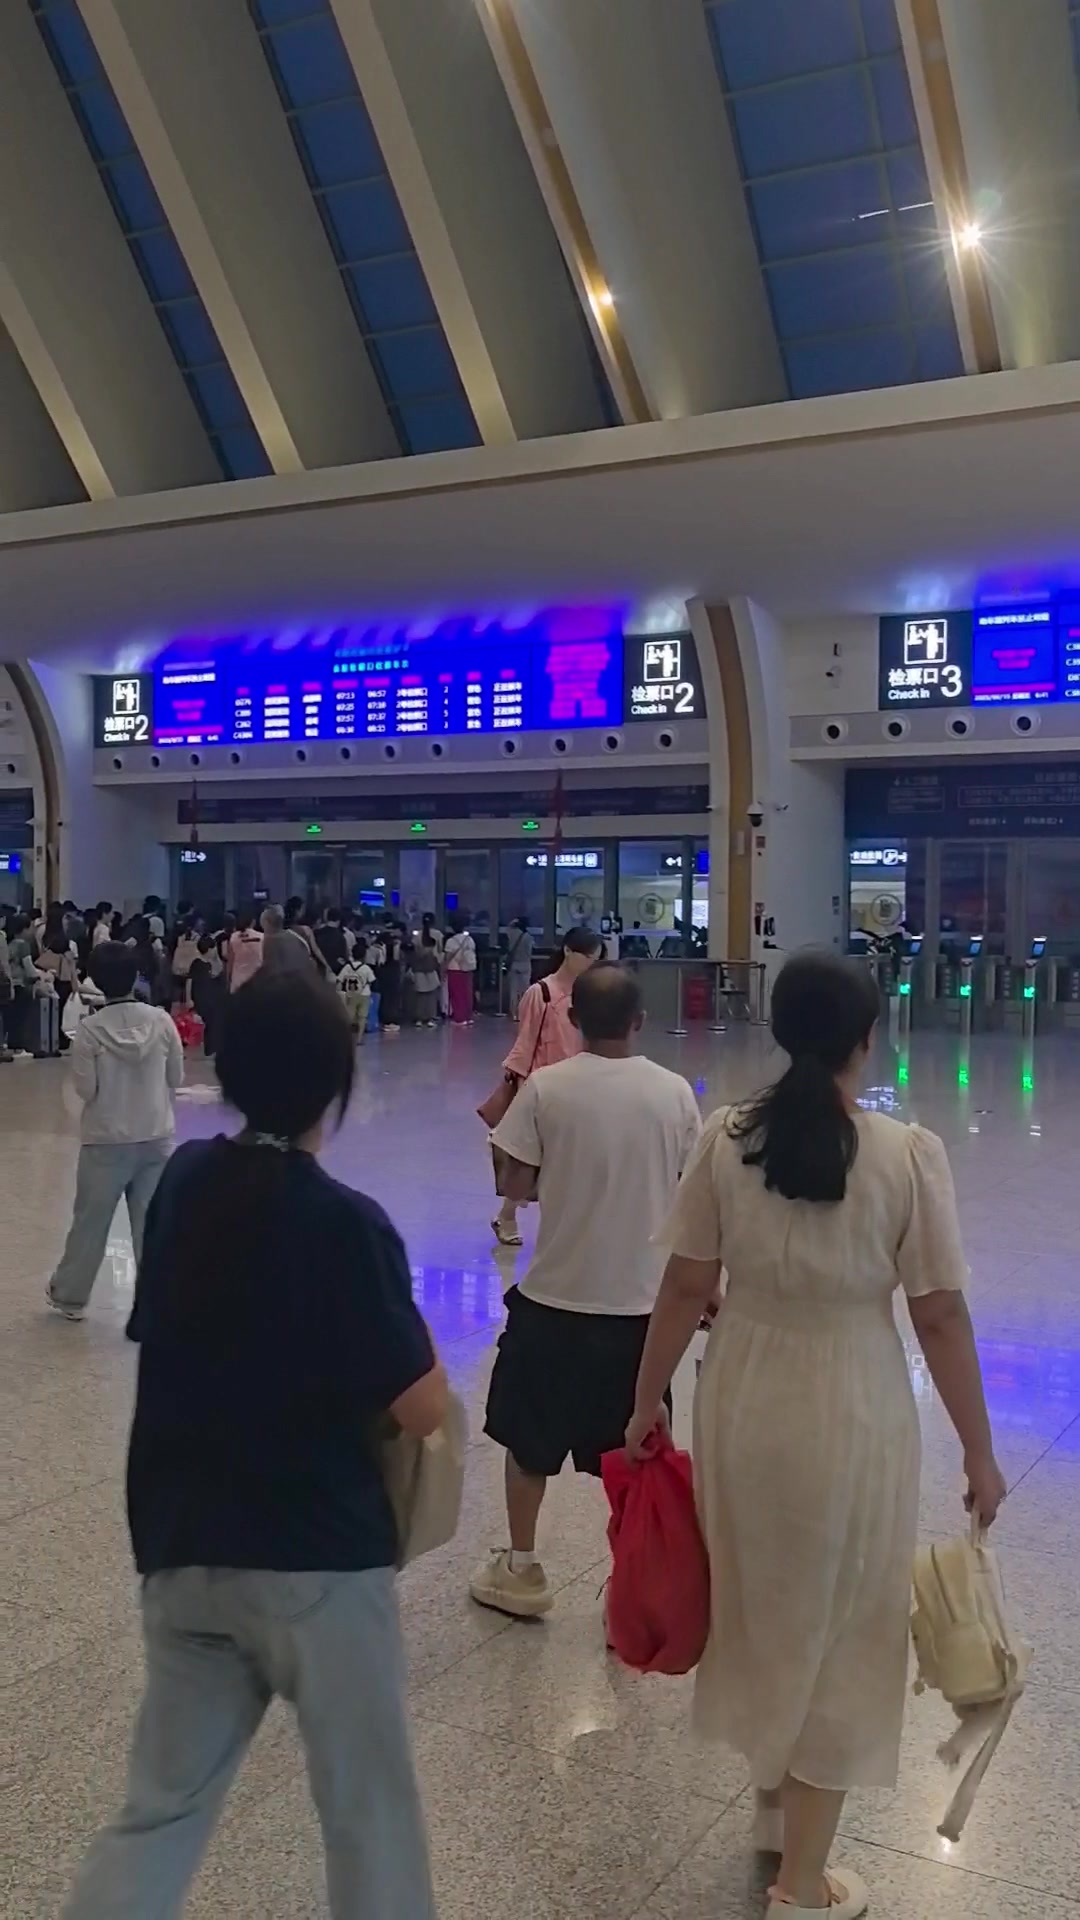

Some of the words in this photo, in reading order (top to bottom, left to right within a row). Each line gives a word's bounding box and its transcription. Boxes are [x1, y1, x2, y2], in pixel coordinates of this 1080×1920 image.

[888, 668, 939, 687] 检票口
[941, 664, 963, 698] 3
[631, 685, 674, 703] 检票口
[674, 682, 694, 713] 2
[888, 689, 920, 700] Check
[631, 704, 657, 715] Check
[104, 717, 135, 731] 检票口
[135, 715, 149, 741] 2
